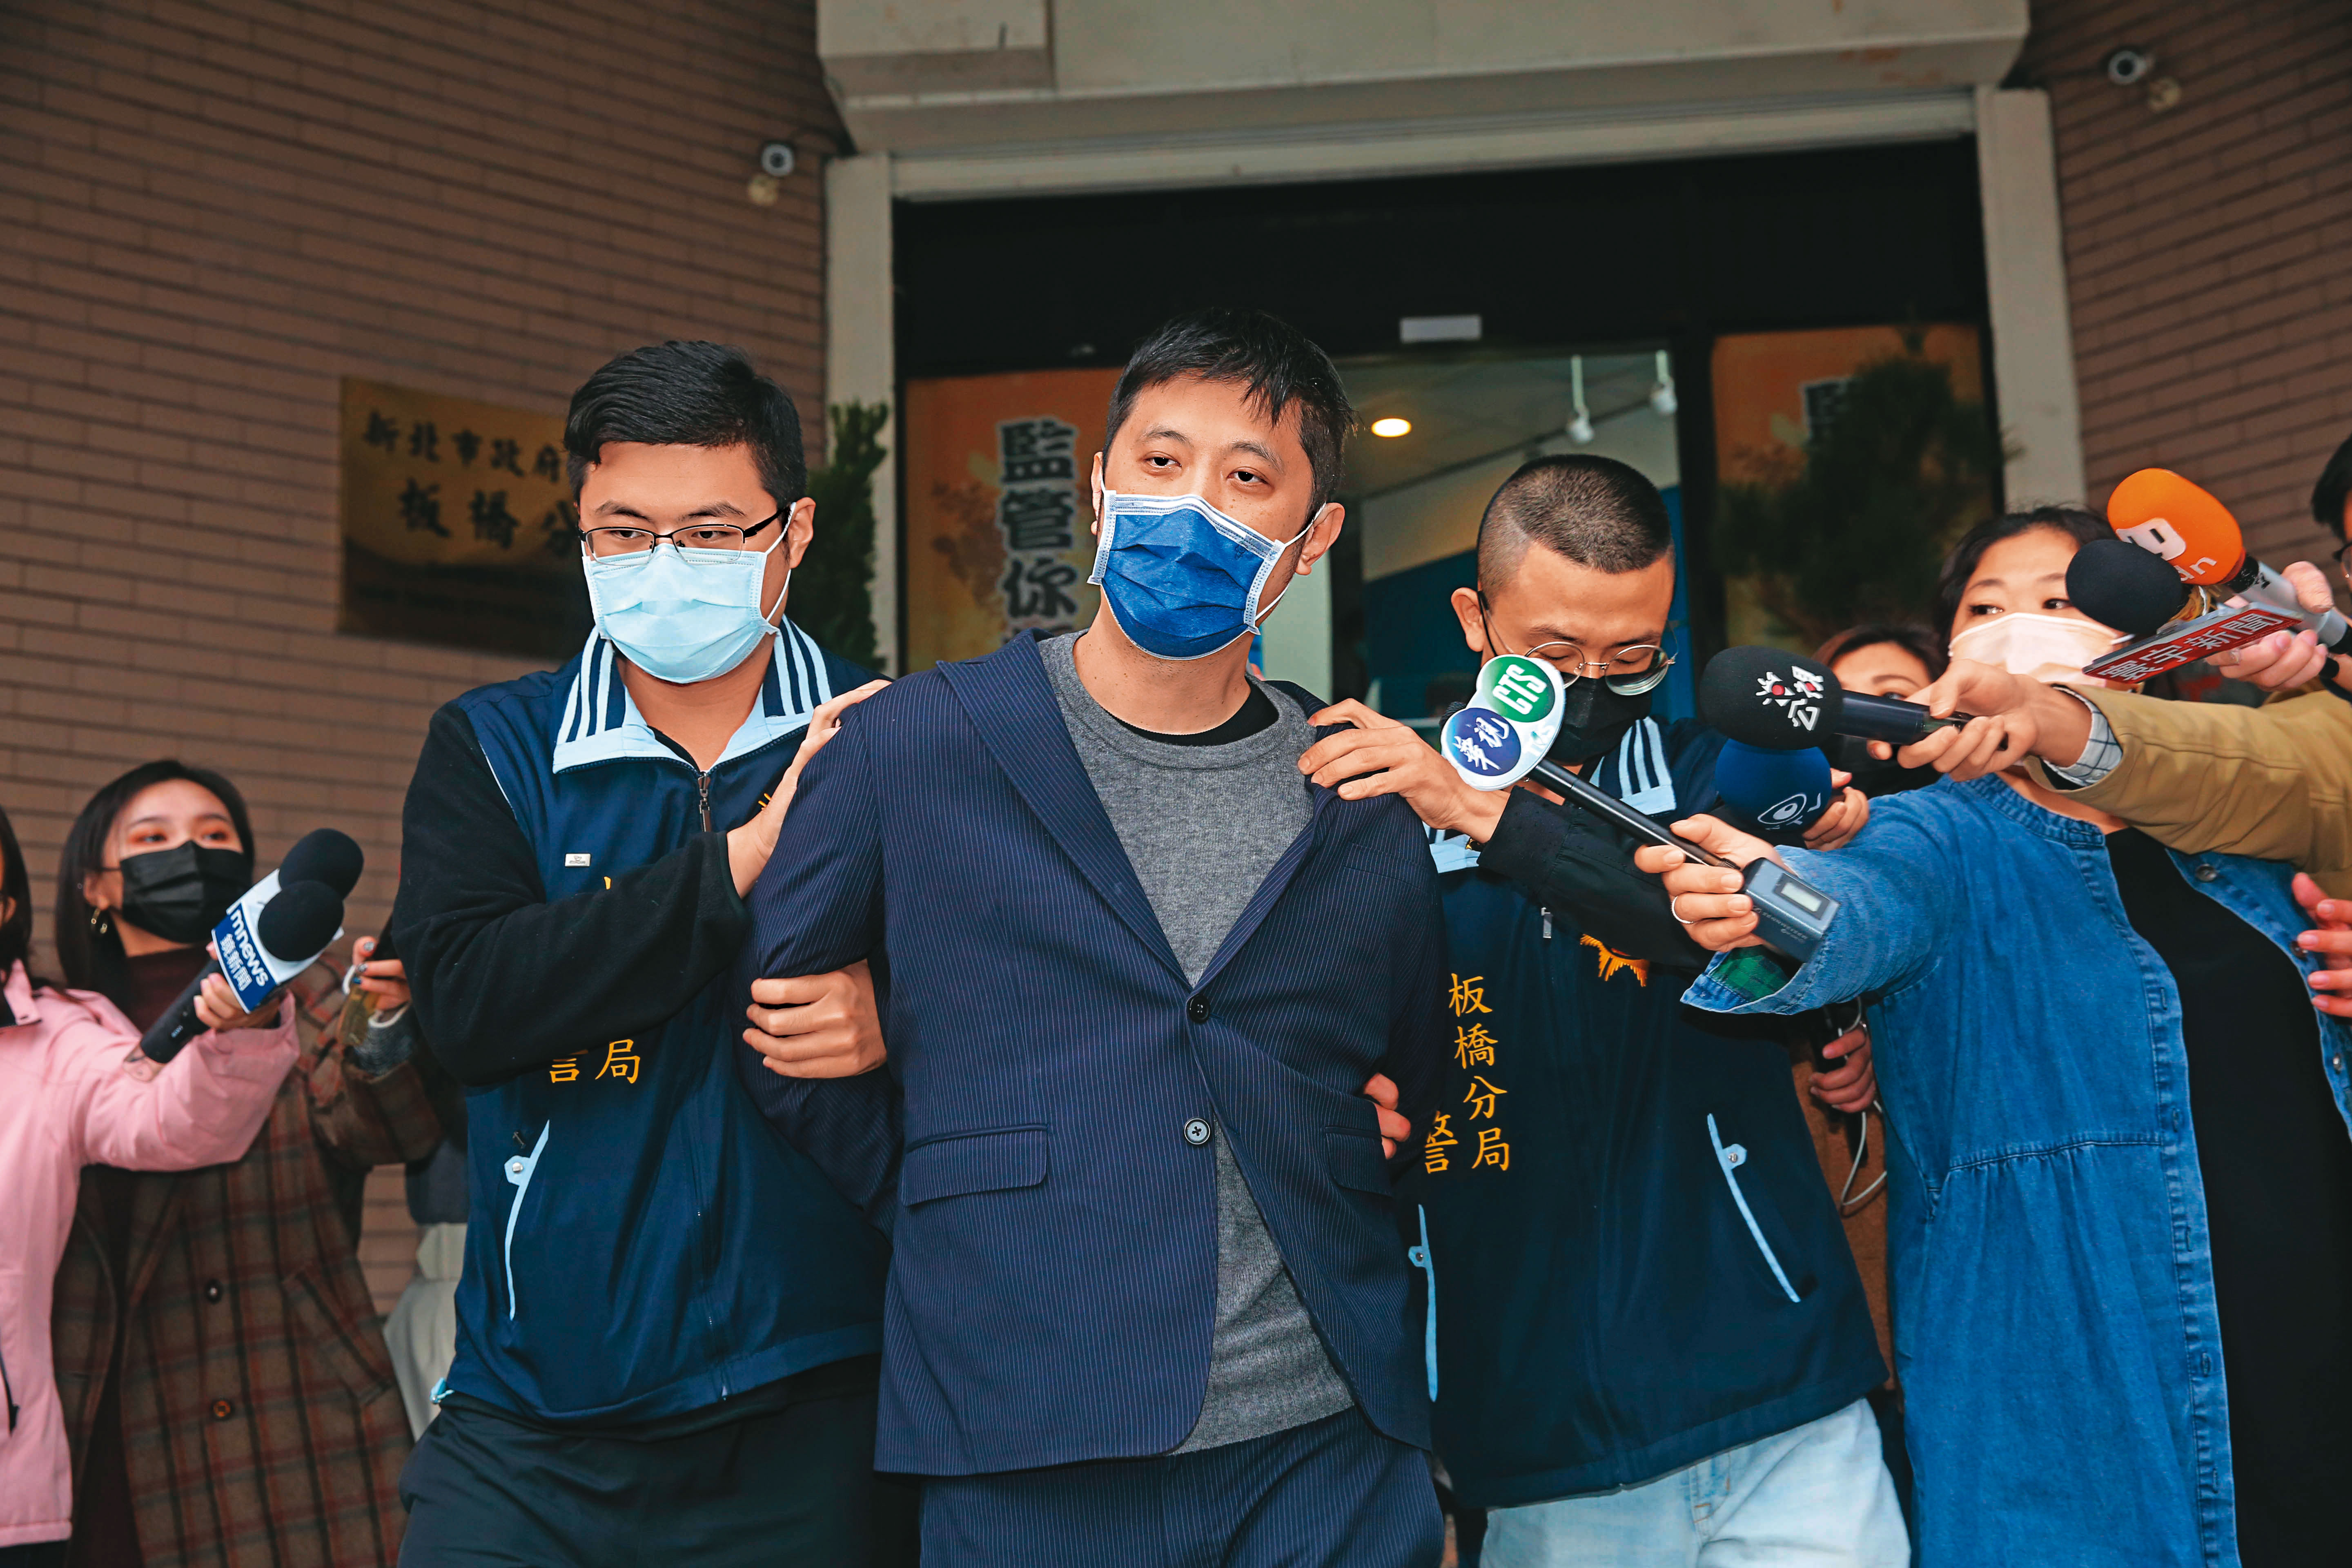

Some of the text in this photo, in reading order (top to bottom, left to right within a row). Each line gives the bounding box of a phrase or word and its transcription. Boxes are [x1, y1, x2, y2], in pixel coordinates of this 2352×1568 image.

[2173, 557, 2217, 581] dn
[2098, 612, 2285, 682] 寰宇新聞
[1492, 664, 1547, 715] CTS
[1452, 717, 1510, 770] 華視
[230, 909, 269, 987] mnews
[1448, 973, 1509, 1171] 板橋分局
